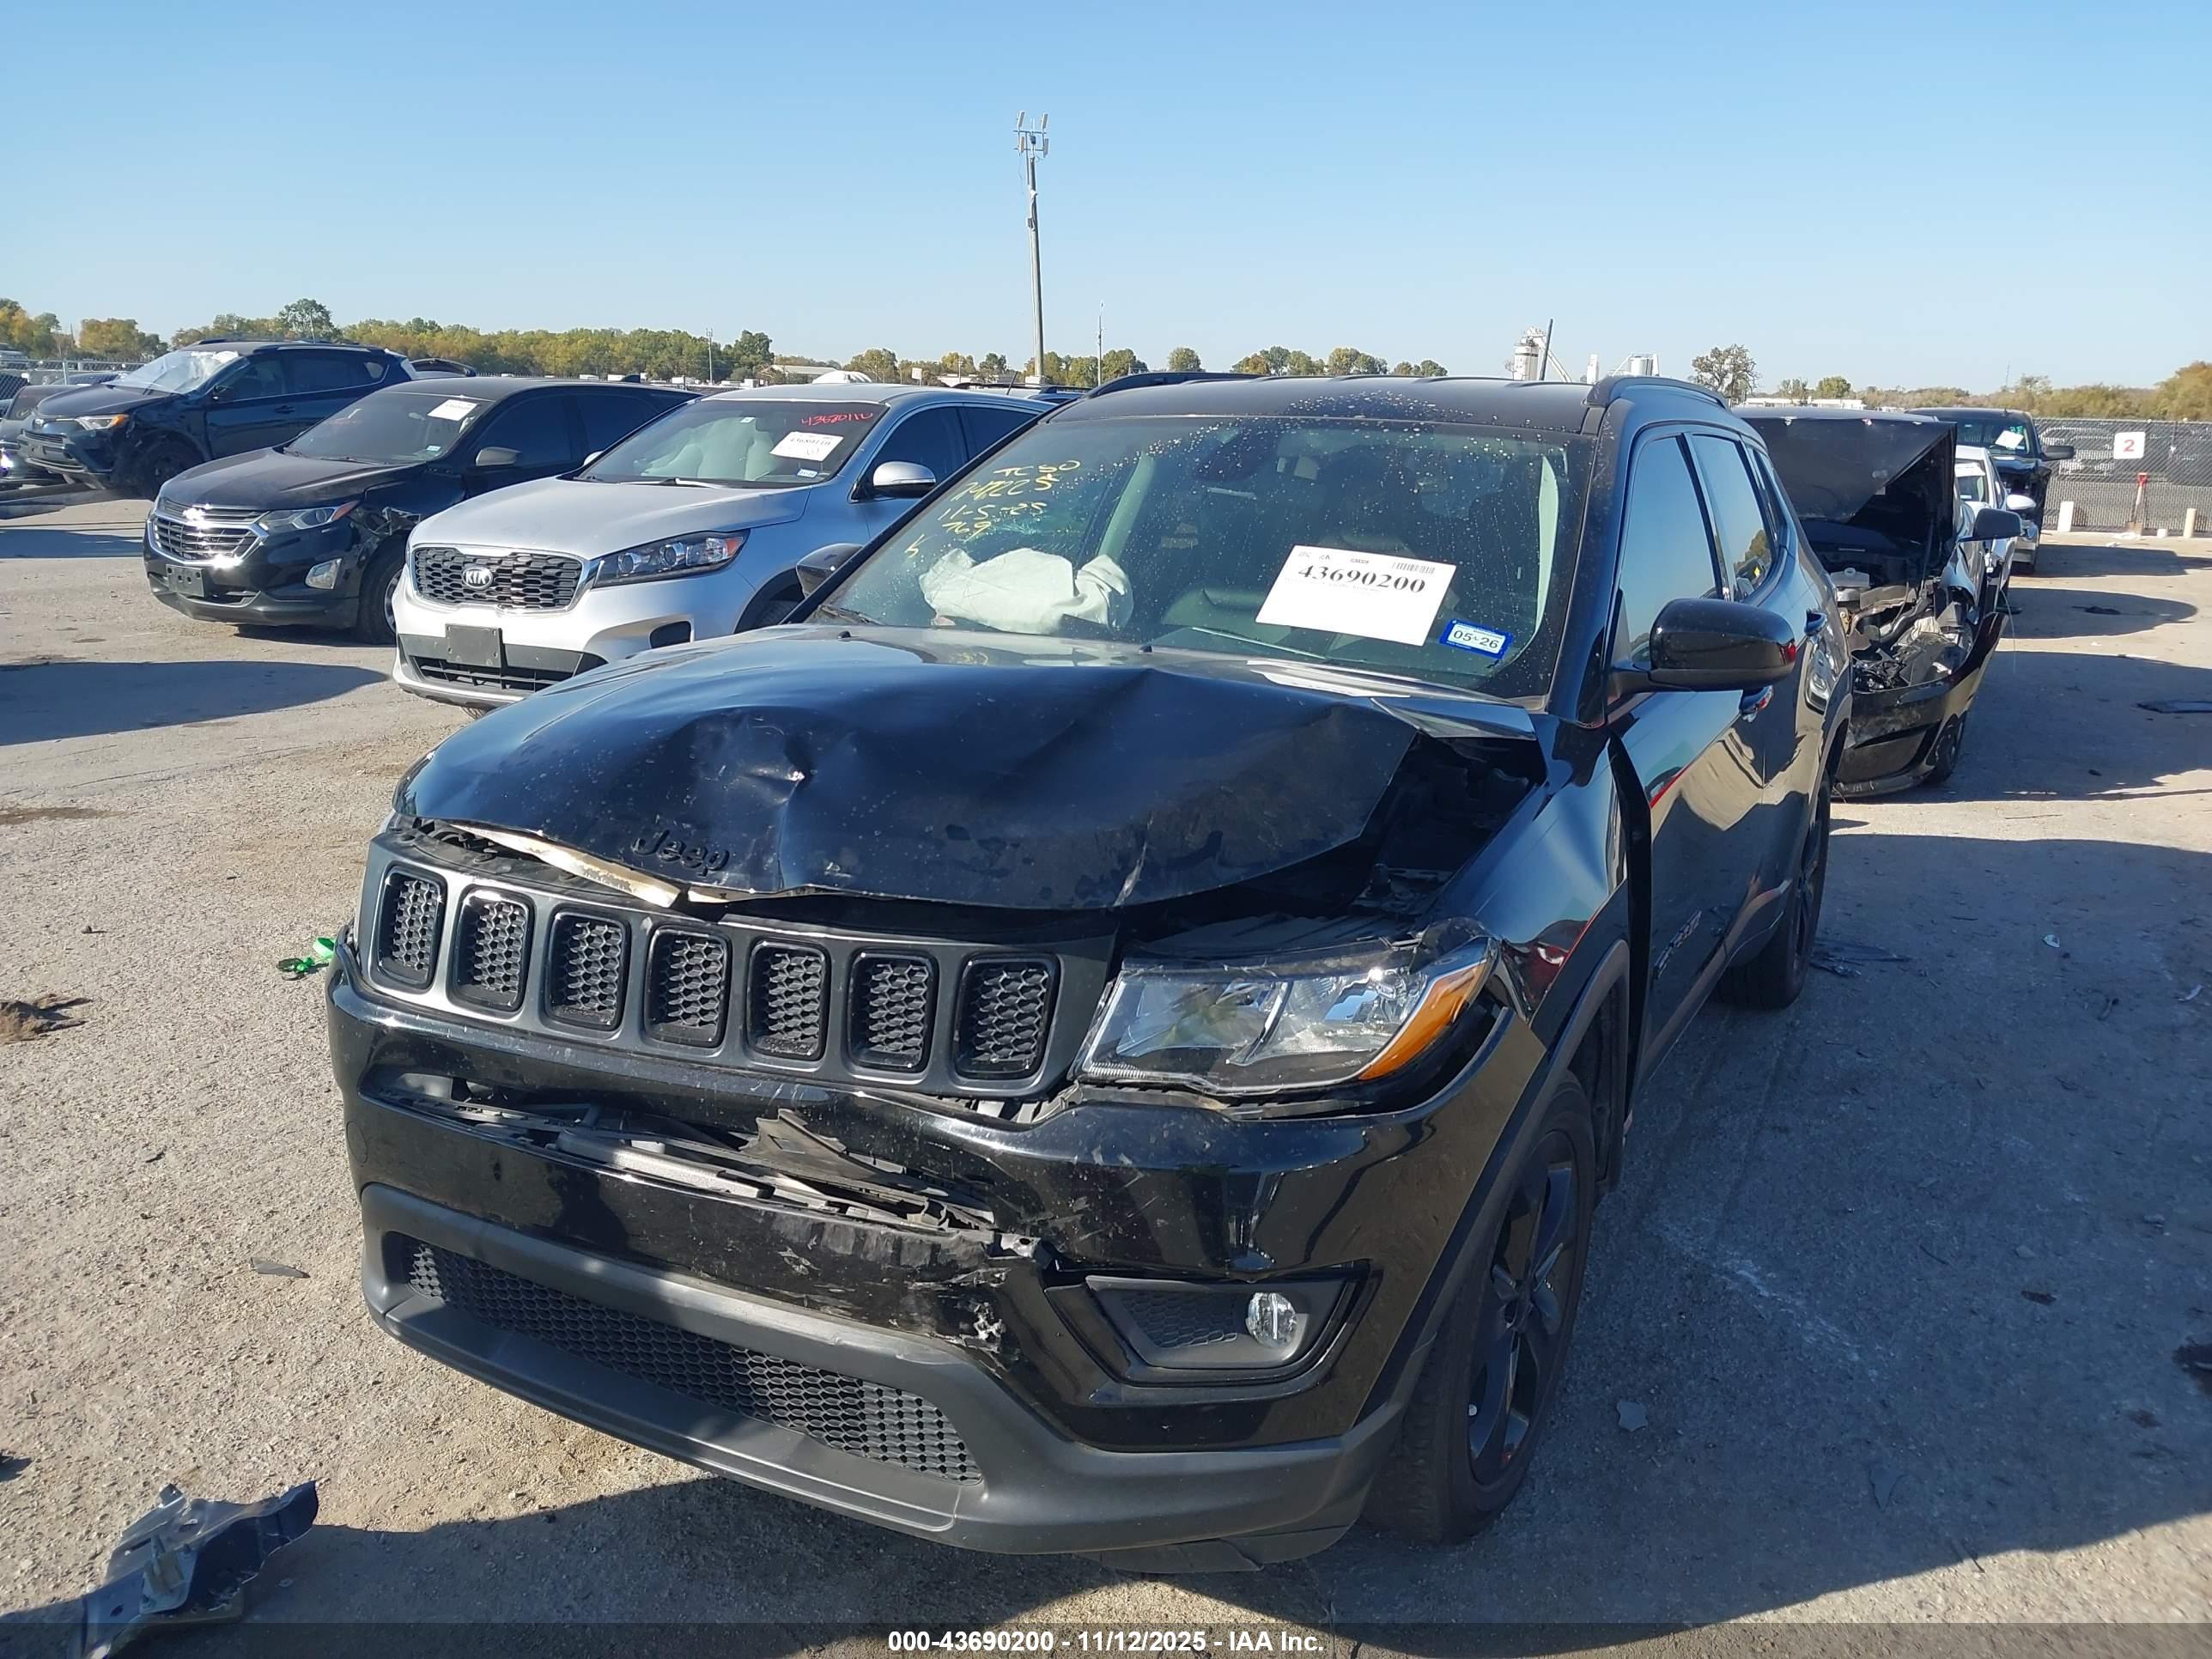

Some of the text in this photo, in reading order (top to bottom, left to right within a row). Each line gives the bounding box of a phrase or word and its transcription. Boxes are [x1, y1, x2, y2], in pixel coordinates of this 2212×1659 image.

[2122, 439, 2136, 452] 2
[1298, 565, 1426, 593] 43690200
[633, 830, 730, 877] Jeep
